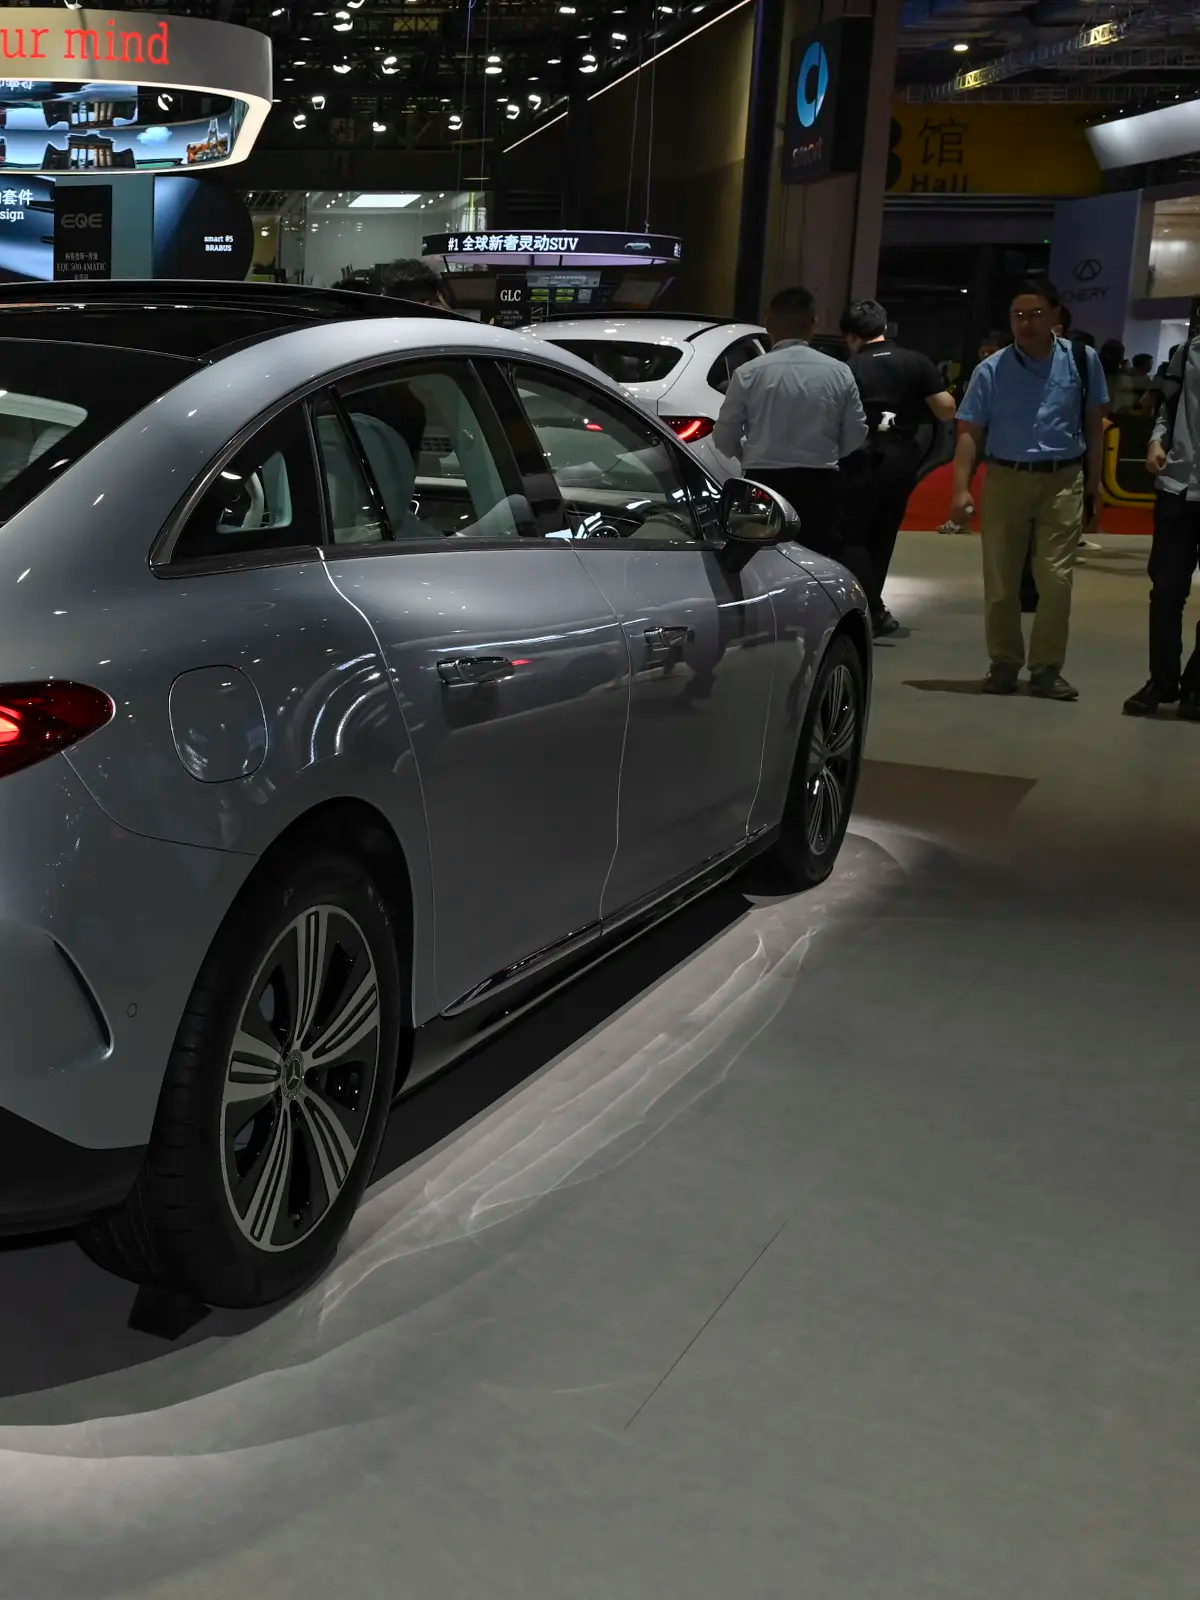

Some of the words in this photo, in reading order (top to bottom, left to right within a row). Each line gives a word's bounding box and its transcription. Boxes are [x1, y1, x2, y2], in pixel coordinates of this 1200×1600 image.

[64, 19, 170, 66] mind
[918, 116, 969, 167] 馆
[911, 173, 969, 193] Hall
[60, 212, 103, 229] EQE
[203, 235, 224, 243] smart
[205, 244, 232, 252] BRABUS
[447, 236, 460, 252] #1
[462, 233, 580, 252] 全球新奢灵动SUV
[500, 289, 522, 302] GLC
